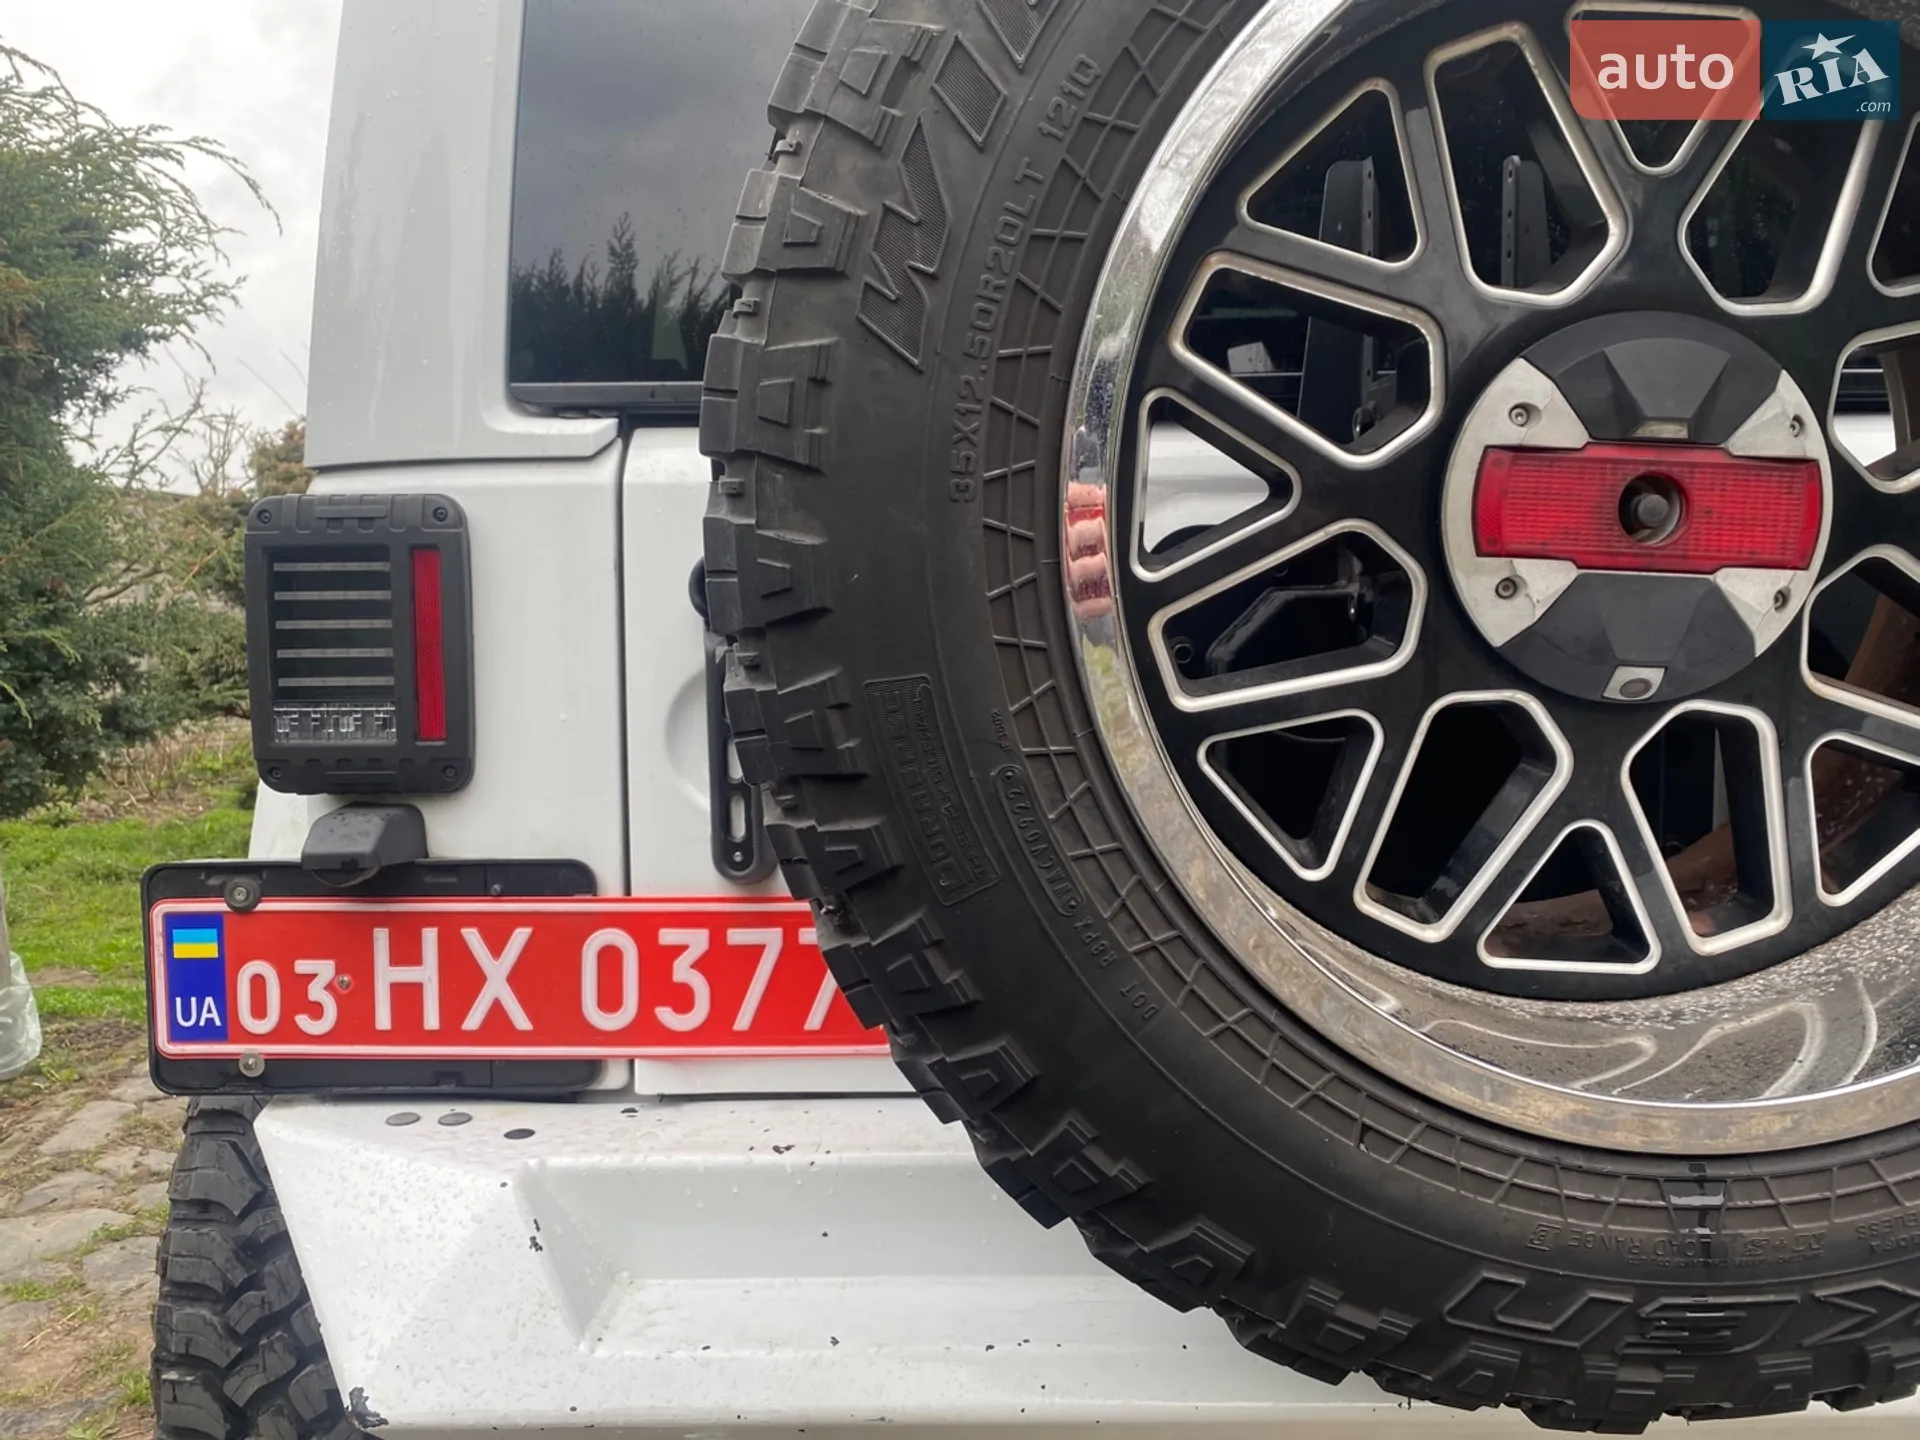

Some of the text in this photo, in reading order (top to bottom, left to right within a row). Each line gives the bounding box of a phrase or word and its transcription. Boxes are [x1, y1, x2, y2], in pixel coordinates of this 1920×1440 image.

[174, 996, 222, 1028] UA
[236, 959, 338, 1036] 03
[372, 927, 534, 1031] HX
